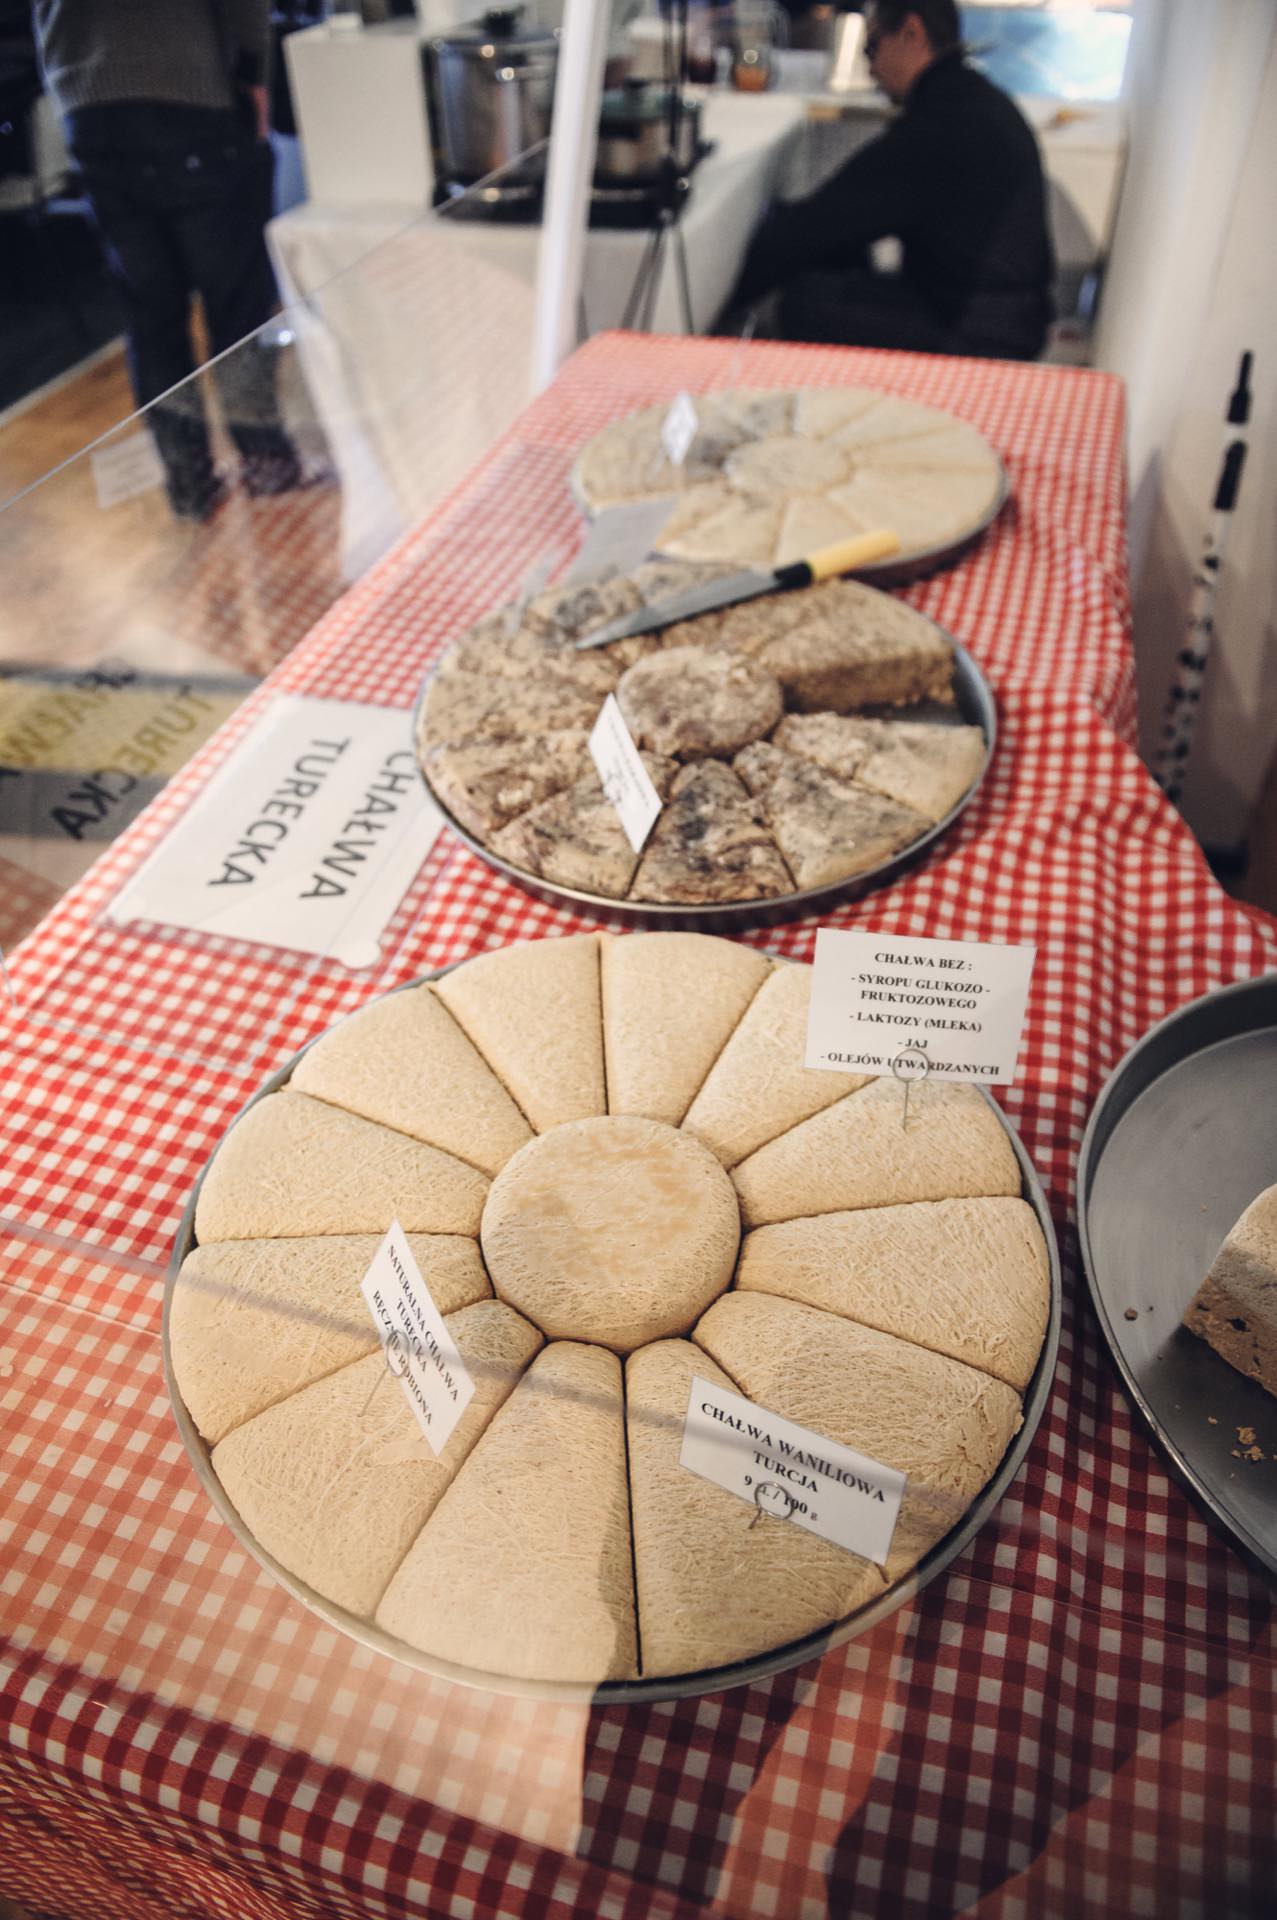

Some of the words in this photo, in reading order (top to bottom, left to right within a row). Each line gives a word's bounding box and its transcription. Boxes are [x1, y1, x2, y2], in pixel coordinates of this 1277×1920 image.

[208, 738, 351, 886] TURECKA
[299, 751, 415, 898] CHAŁWA
[939, 958, 965, 970] BEZ
[858, 974, 912, 988] SYROPU
[915, 979, 983, 994] GLUKOZO
[860, 990, 977, 1009] FRUKTOZOWEGO
[857, 1012, 921, 1027] LAKTOZY
[924, 1018, 982, 1033] (MLEKA)
[905, 1038, 928, 1049] JAJ
[827, 1052, 886, 1065] OLEJÓW
[887, 1058, 1000, 1075] UTWARDZANYCH
[388, 1245, 425, 1331] NATURALNA
[396, 1297, 427, 1372] TURECKA
[701, 1402, 772, 1447] CHAŁWA
[779, 1439, 886, 1502] WANILIOWA
[753, 1450, 818, 1493] TURCJA
